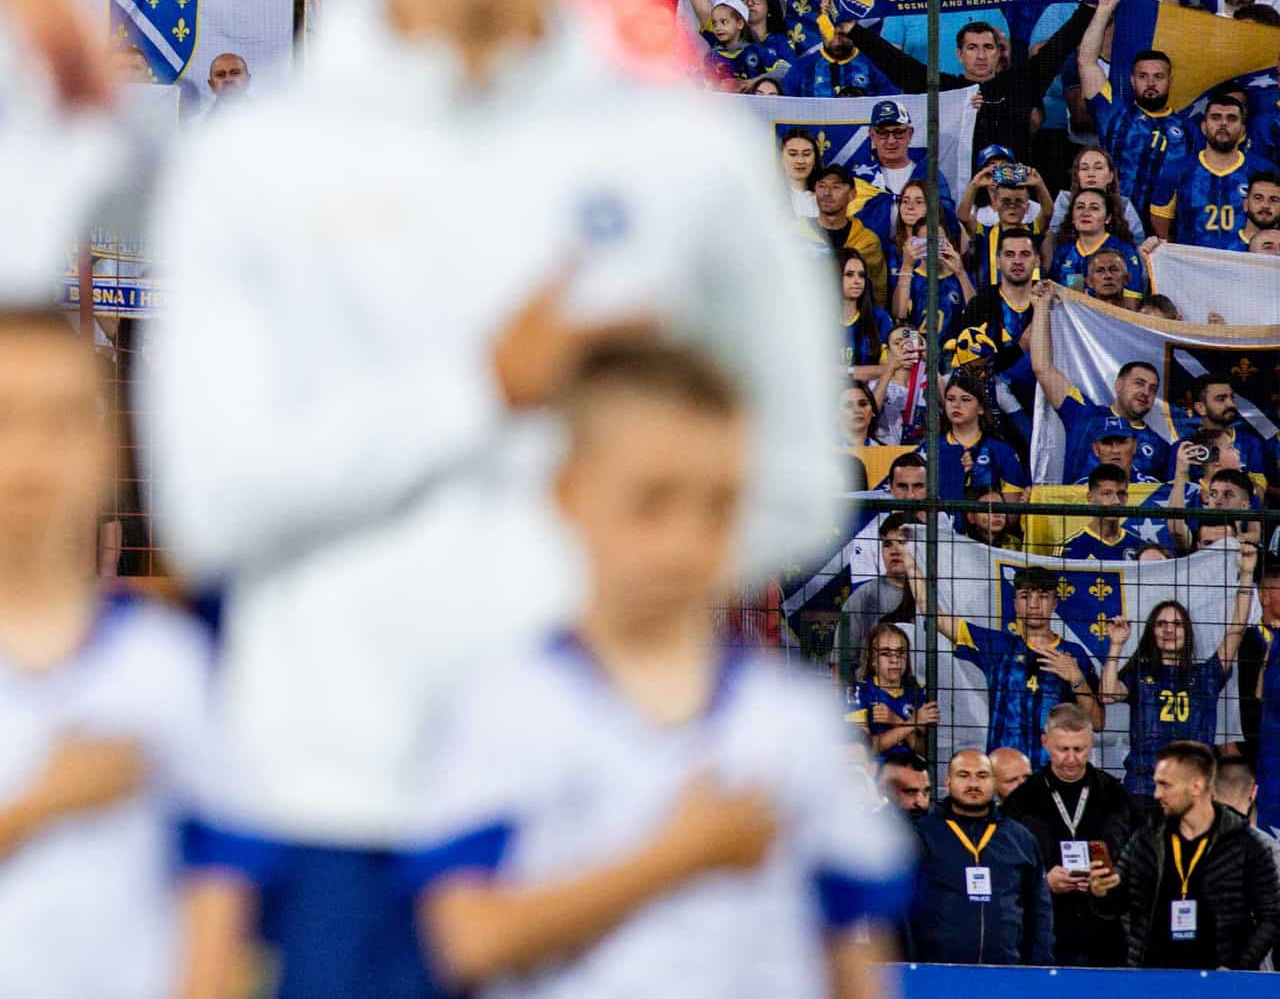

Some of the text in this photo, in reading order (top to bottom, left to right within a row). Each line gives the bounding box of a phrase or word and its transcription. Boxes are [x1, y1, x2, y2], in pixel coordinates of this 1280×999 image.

[1204, 204, 1235, 232] 20
[69, 287, 125, 305] BSNA
[1026, 675, 1039, 692] 4
[1159, 689, 1190, 723] 20
